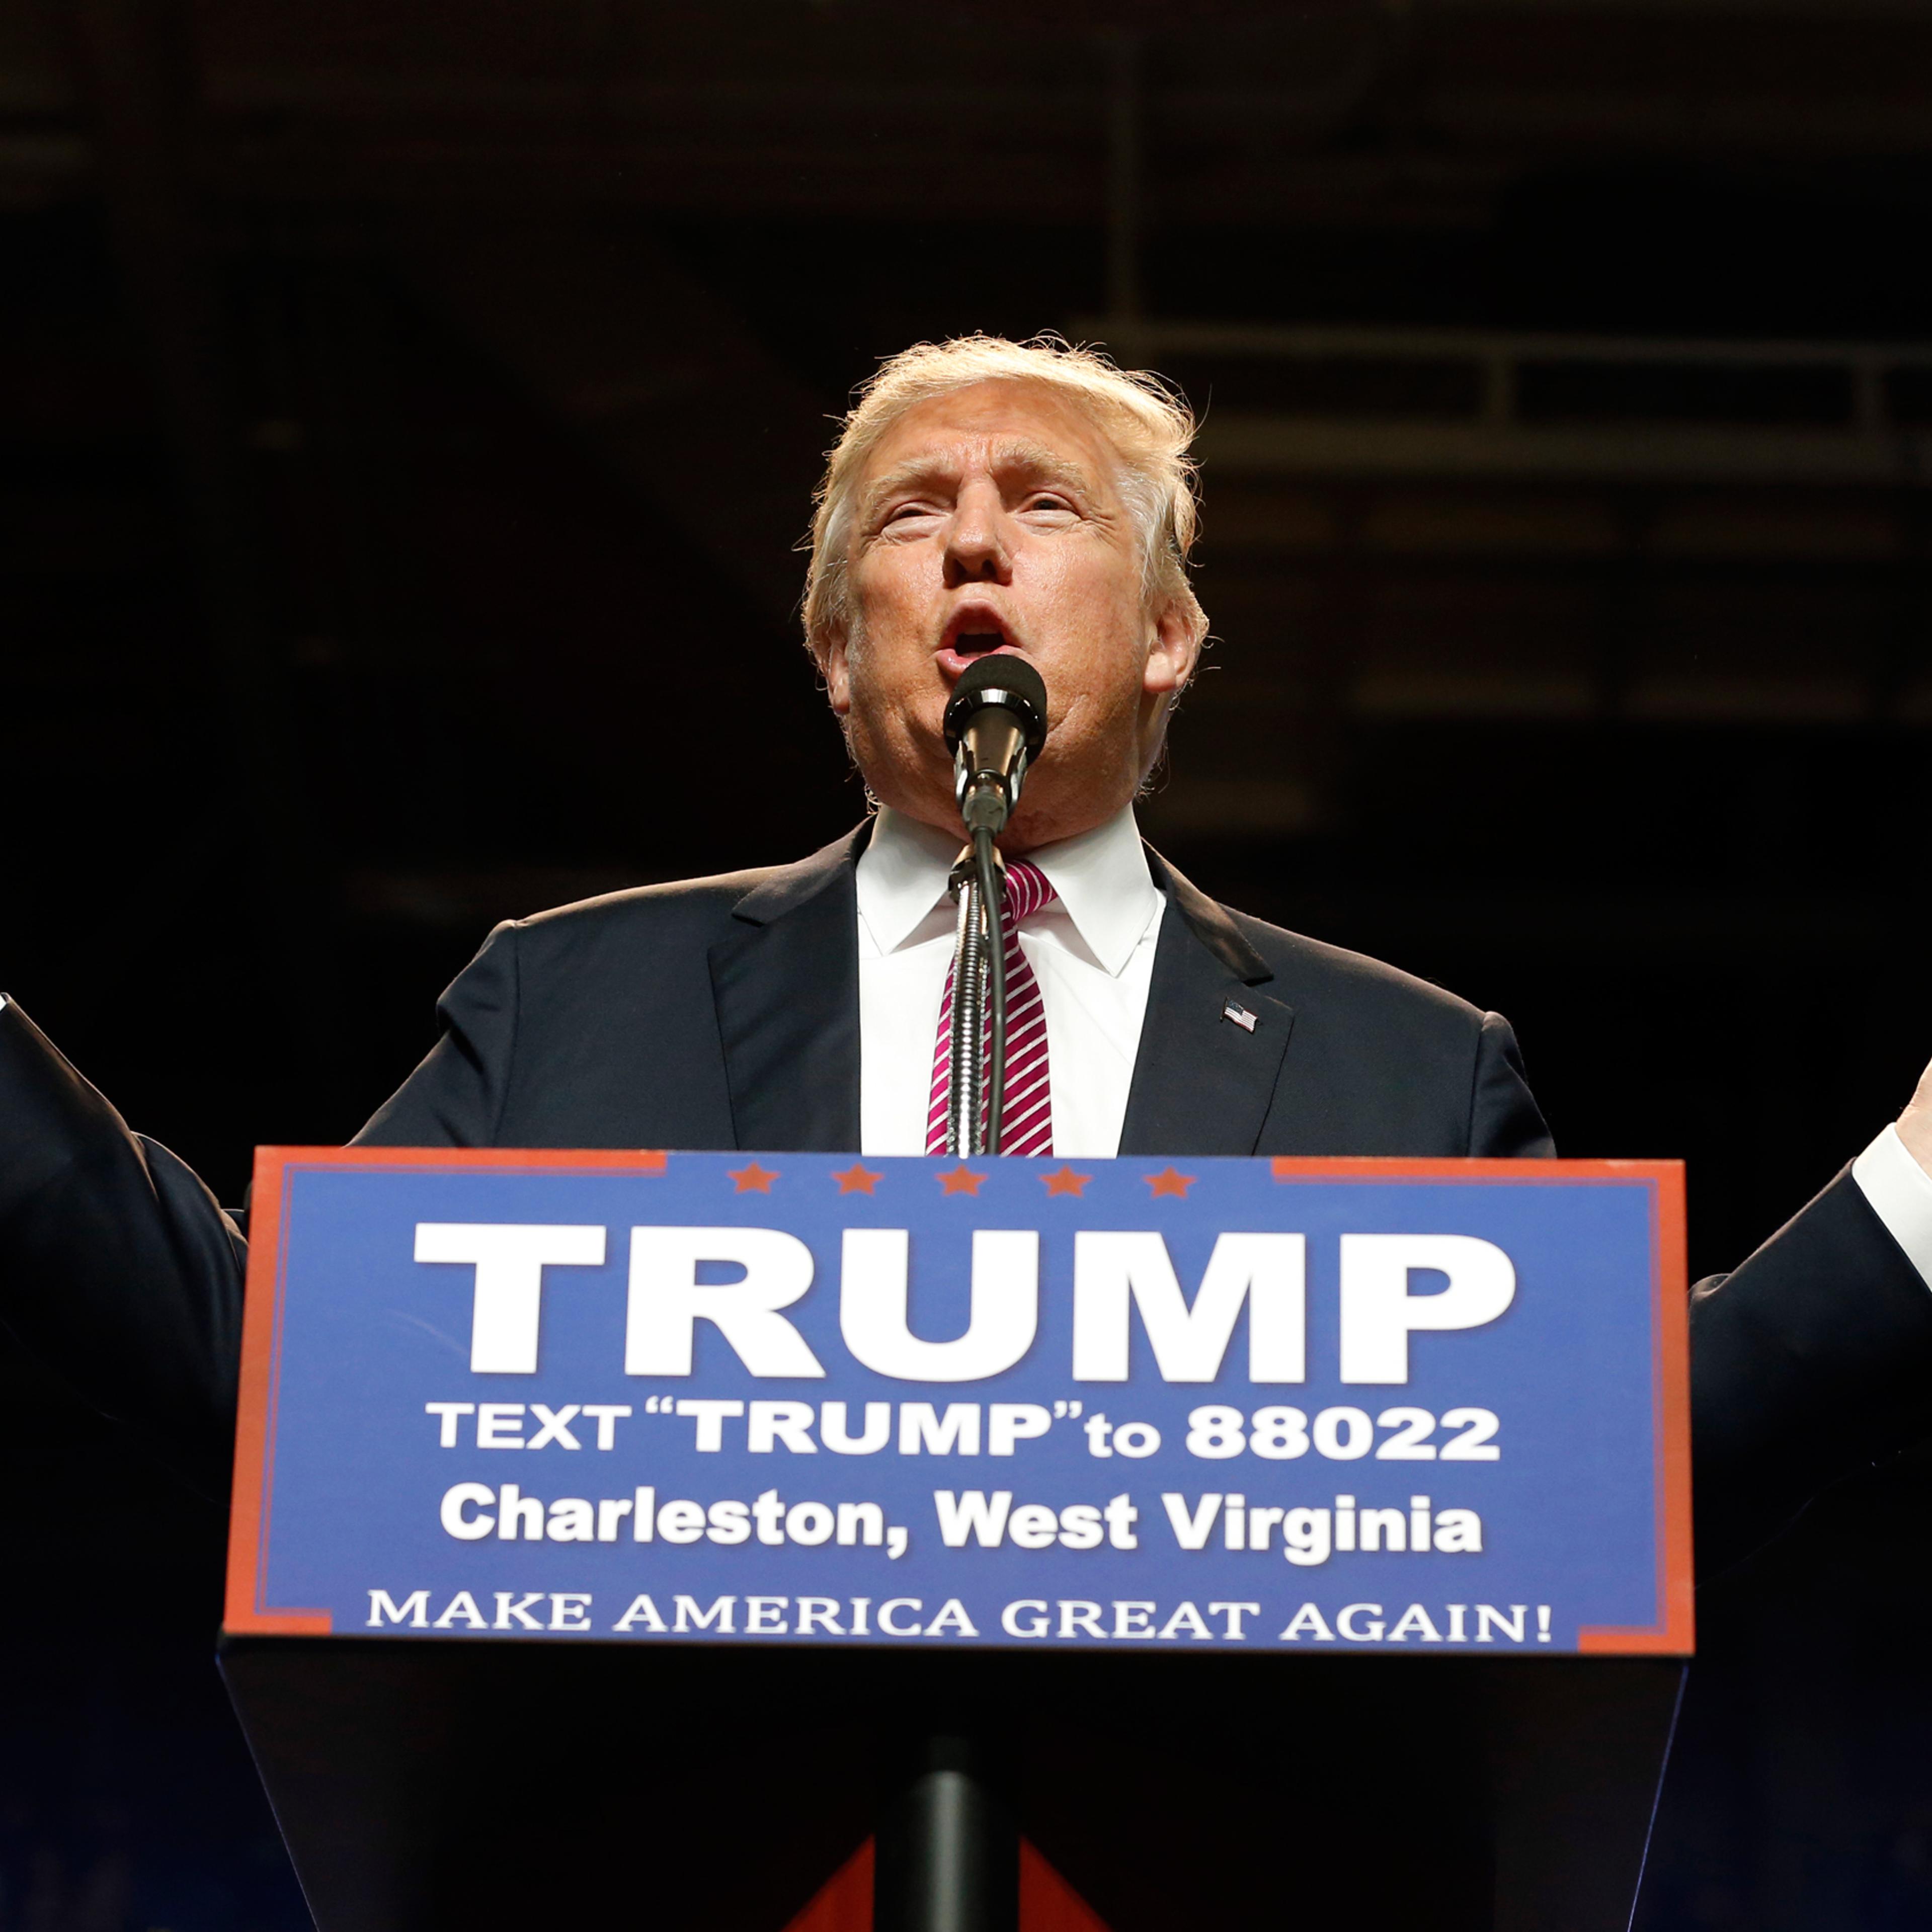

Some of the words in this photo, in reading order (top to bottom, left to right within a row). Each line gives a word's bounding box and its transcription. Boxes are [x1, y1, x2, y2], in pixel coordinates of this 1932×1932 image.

[414, 1223, 1515, 1384] TRUMP
[425, 1402, 632, 1451] TEXT
[646, 1396, 1082, 1457] “TRUMP”
[1084, 1413, 1161, 1458] to
[1186, 1405, 1500, 1461] 88022
[441, 1483, 908, 1560] Charleston,
[934, 1490, 1138, 1550] West
[1161, 1493, 1482, 1565] Virginia
[366, 1590, 592, 1631] MAKE
[612, 1594, 979, 1638] AMERICA
[1001, 1599, 1261, 1640] GREAT
[1279, 1602, 1551, 1643] AGAIN!
